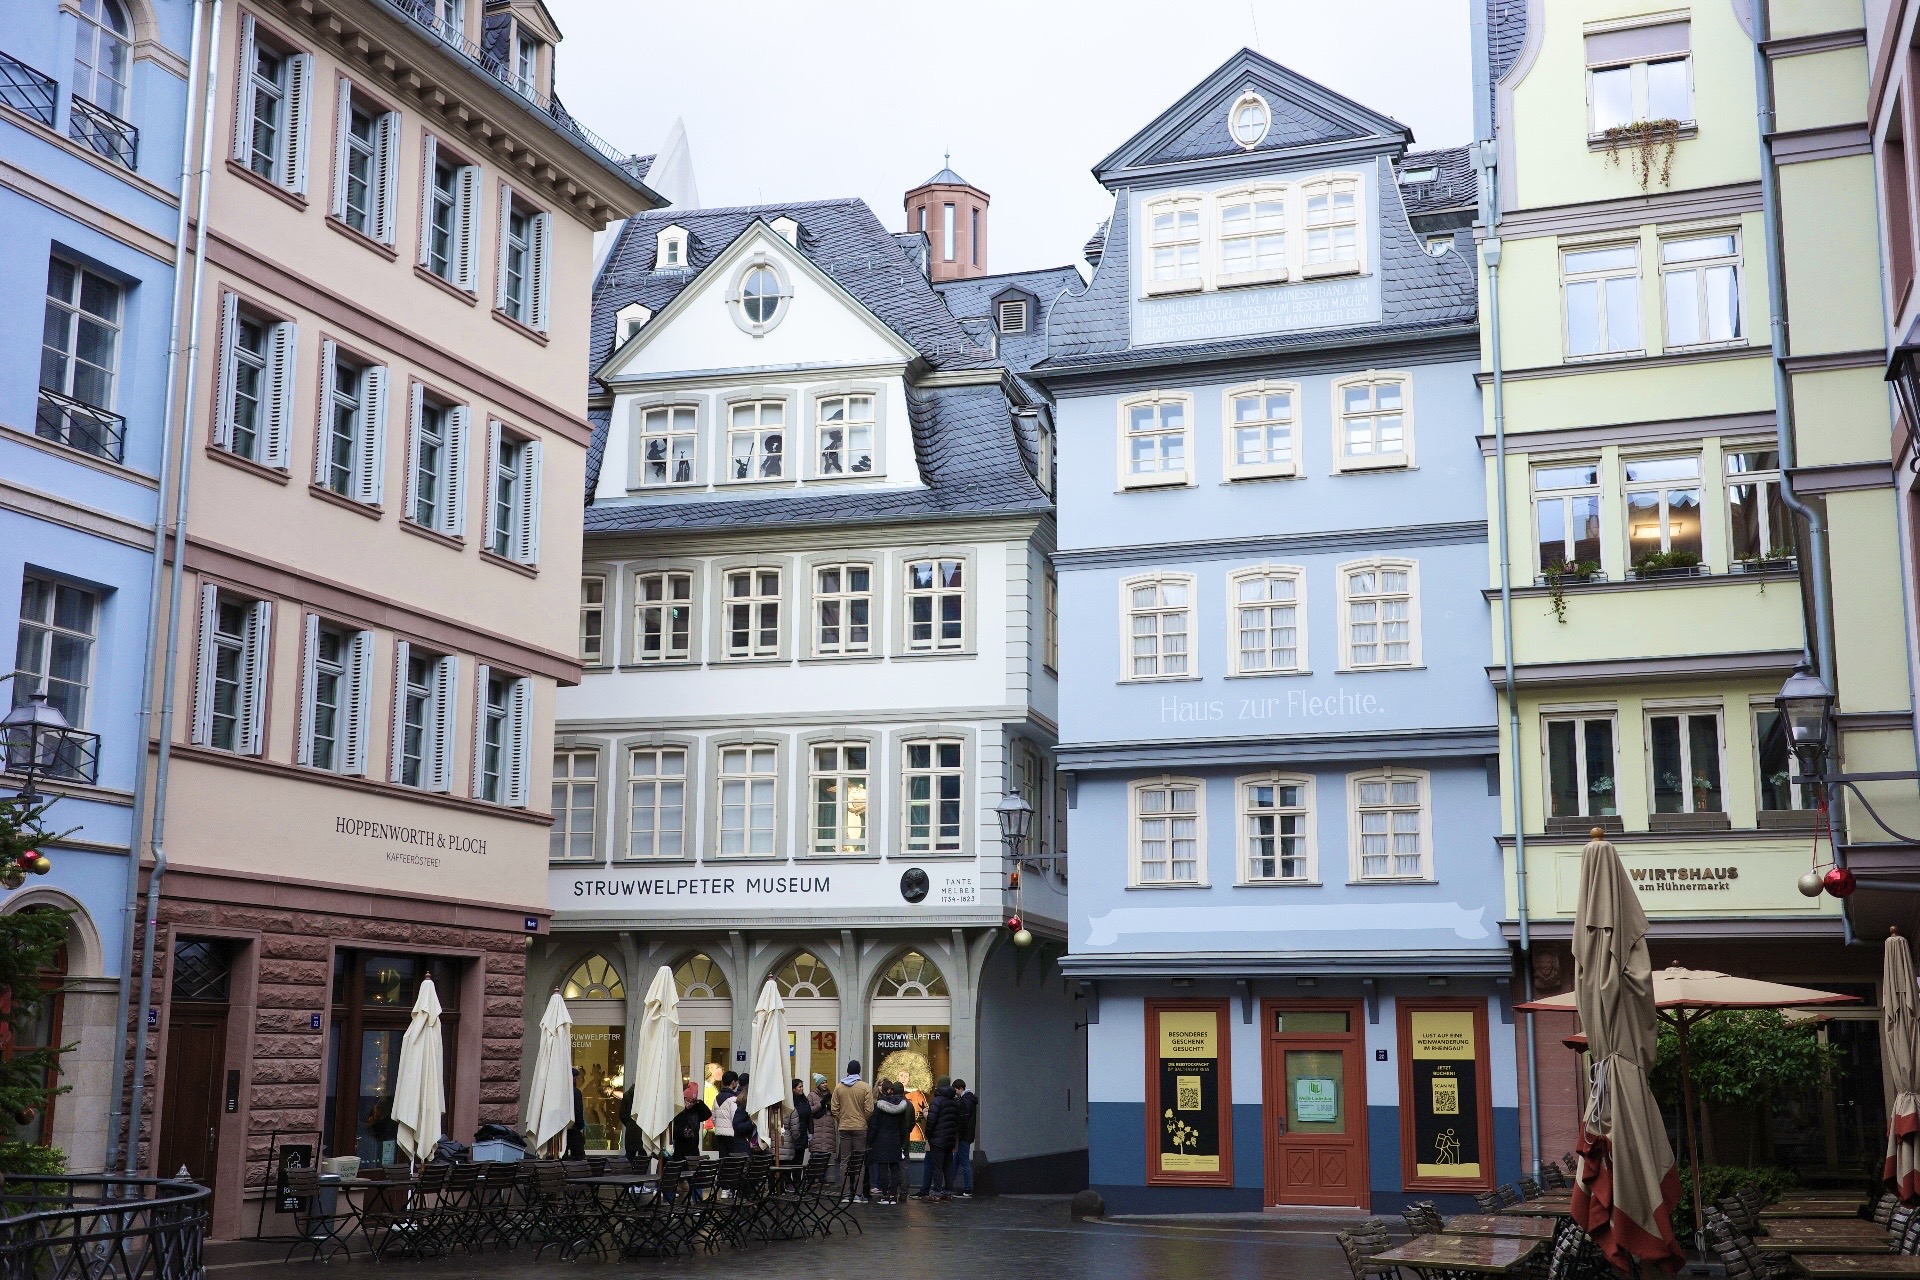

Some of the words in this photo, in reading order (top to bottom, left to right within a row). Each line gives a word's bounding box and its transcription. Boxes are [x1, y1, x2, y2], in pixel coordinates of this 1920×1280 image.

[1142, 300, 1200, 316] FRANKFURT
[1206, 296, 1233, 310] LIEGT
[1241, 293, 1259, 306] AM
[1266, 284, 1347, 304] MAINESSTRAND
[1353, 281, 1369, 294] AM
[1143, 311, 1216, 329] RHEINESSTRAND
[1219, 307, 1242, 321] LIEGT
[1271, 303, 1289, 316] ZUM
[1293, 298, 1329, 313] BESSER
[1332, 294, 1369, 308] MACHEN
[1142, 326, 1175, 341] GEHÖRT
[1177, 322, 1223, 337] VERSTAND
[1226, 315, 1281, 332] KRITISIEREN
[1285, 311, 1312, 326] KANN
[1312, 309, 1344, 323] JEDER
[1346, 307, 1369, 319] ESEL
[1161, 695, 1224, 723] Haus
[1237, 697, 1280, 720] zur
[1287, 687, 1386, 718] Flechte.
[335, 816, 435, 847] HOPPENWORTH
[437, 833, 446, 849] &
[448, 834, 487, 855] PLOCH
[386, 852, 441, 868] KAFFEERÖSTEREI
[1629, 867, 1739, 881] WIRTSHAUS
[573, 878, 735, 896] STRUWWELPETER
[746, 877, 830, 894] MUSEUM
[1656, 882, 1730, 891] Hühnermarkt
[570, 1033, 621, 1041] RUWWELPETER
[877, 1033, 941, 1041] STRUWWELPETER
